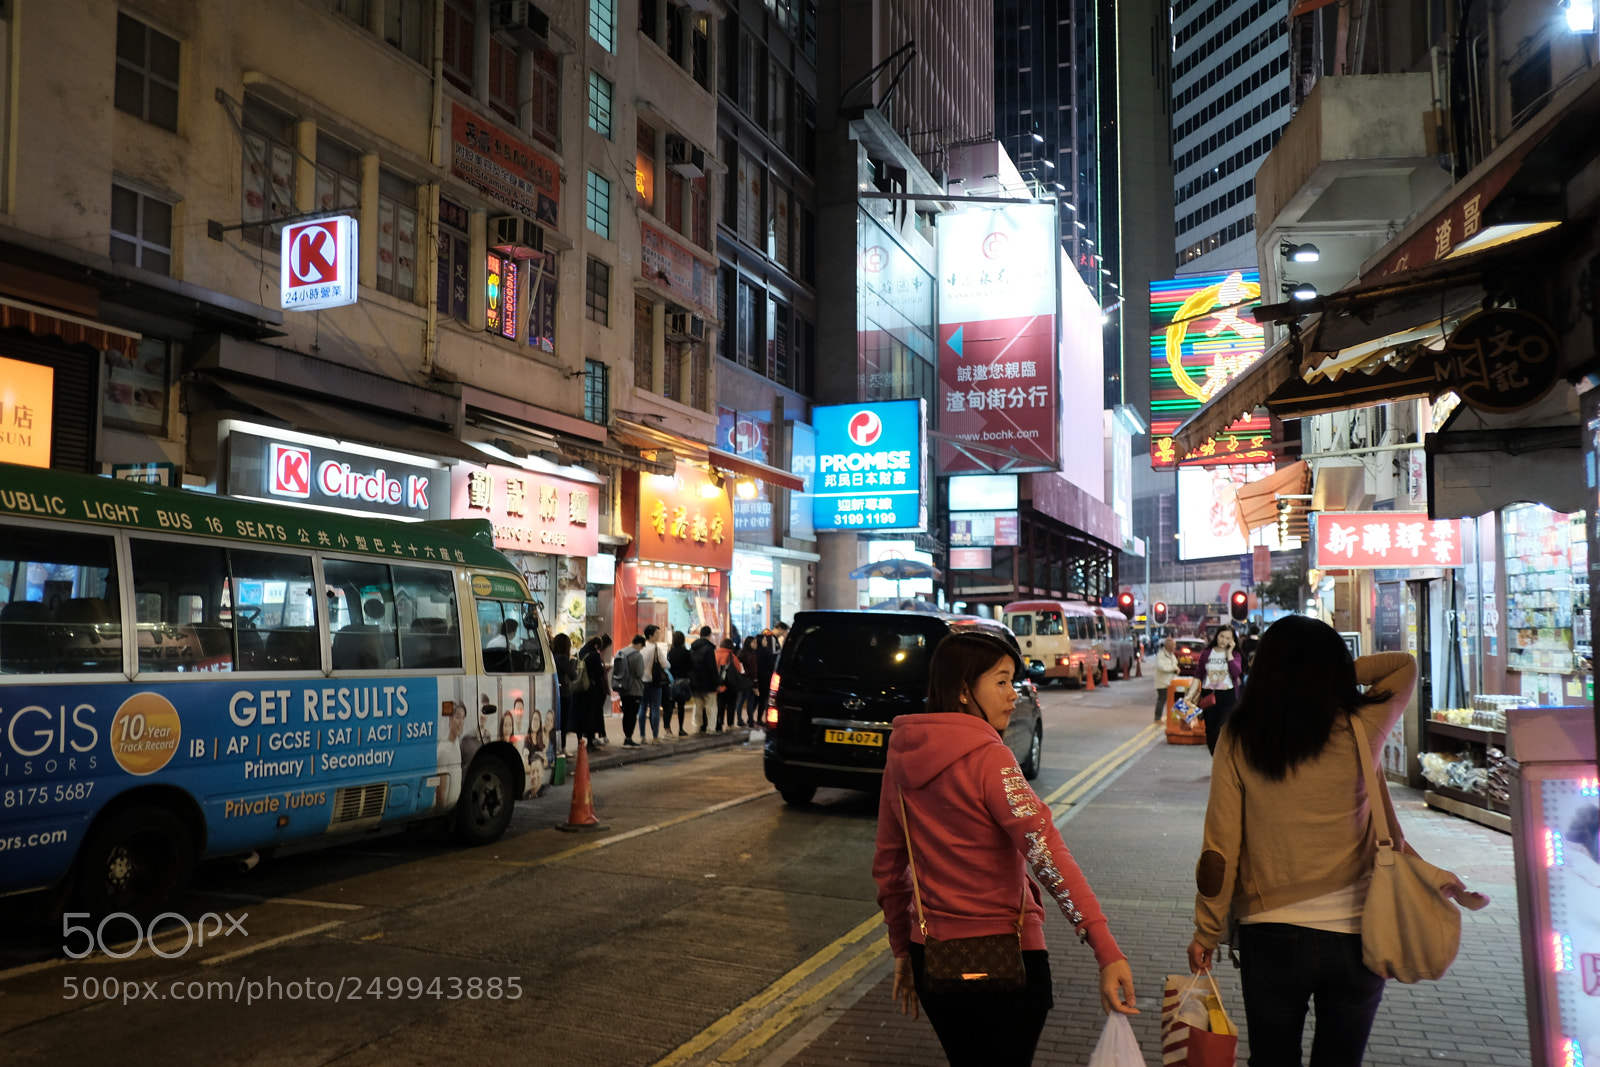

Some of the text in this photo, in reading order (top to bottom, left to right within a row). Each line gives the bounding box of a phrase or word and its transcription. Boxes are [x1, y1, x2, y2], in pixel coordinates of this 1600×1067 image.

[455, 158, 474, 175] Foot
[475, 168, 511, 196] Steaming
[520, 194, 535, 208] Spa
[1434, 193, 1481, 260] 渣哥
[285, 286, 342, 304] 24小時營業
[956, 361, 1037, 382] 誠邀您親臨
[946, 385, 1048, 412] 渣甸街分行
[955, 429, 1039, 441] www.bochk.com
[820, 450, 911, 473] PROMISE
[319, 461, 430, 510] Circle K
[824, 471, 907, 488] 邦民日本財務
[0, 489, 466, 563] UBLIC LIGHT BUS 16 SEATS 公共小型巴士十六座位
[834, 512, 897, 525] 3199 1199
[229, 685, 410, 728] GET RESULTS
[0, 703, 99, 757] GIS
[189, 721, 434, 759] IB AP GCSE SAT ACT SSAT
[829, 730, 881, 744] TD 4074
[119, 739, 175, 754] Track Record
[244, 749, 395, 781] Primary Secondary
[4, 782, 95, 808] 8175 5687
[224, 790, 326, 820] Private Tutors
